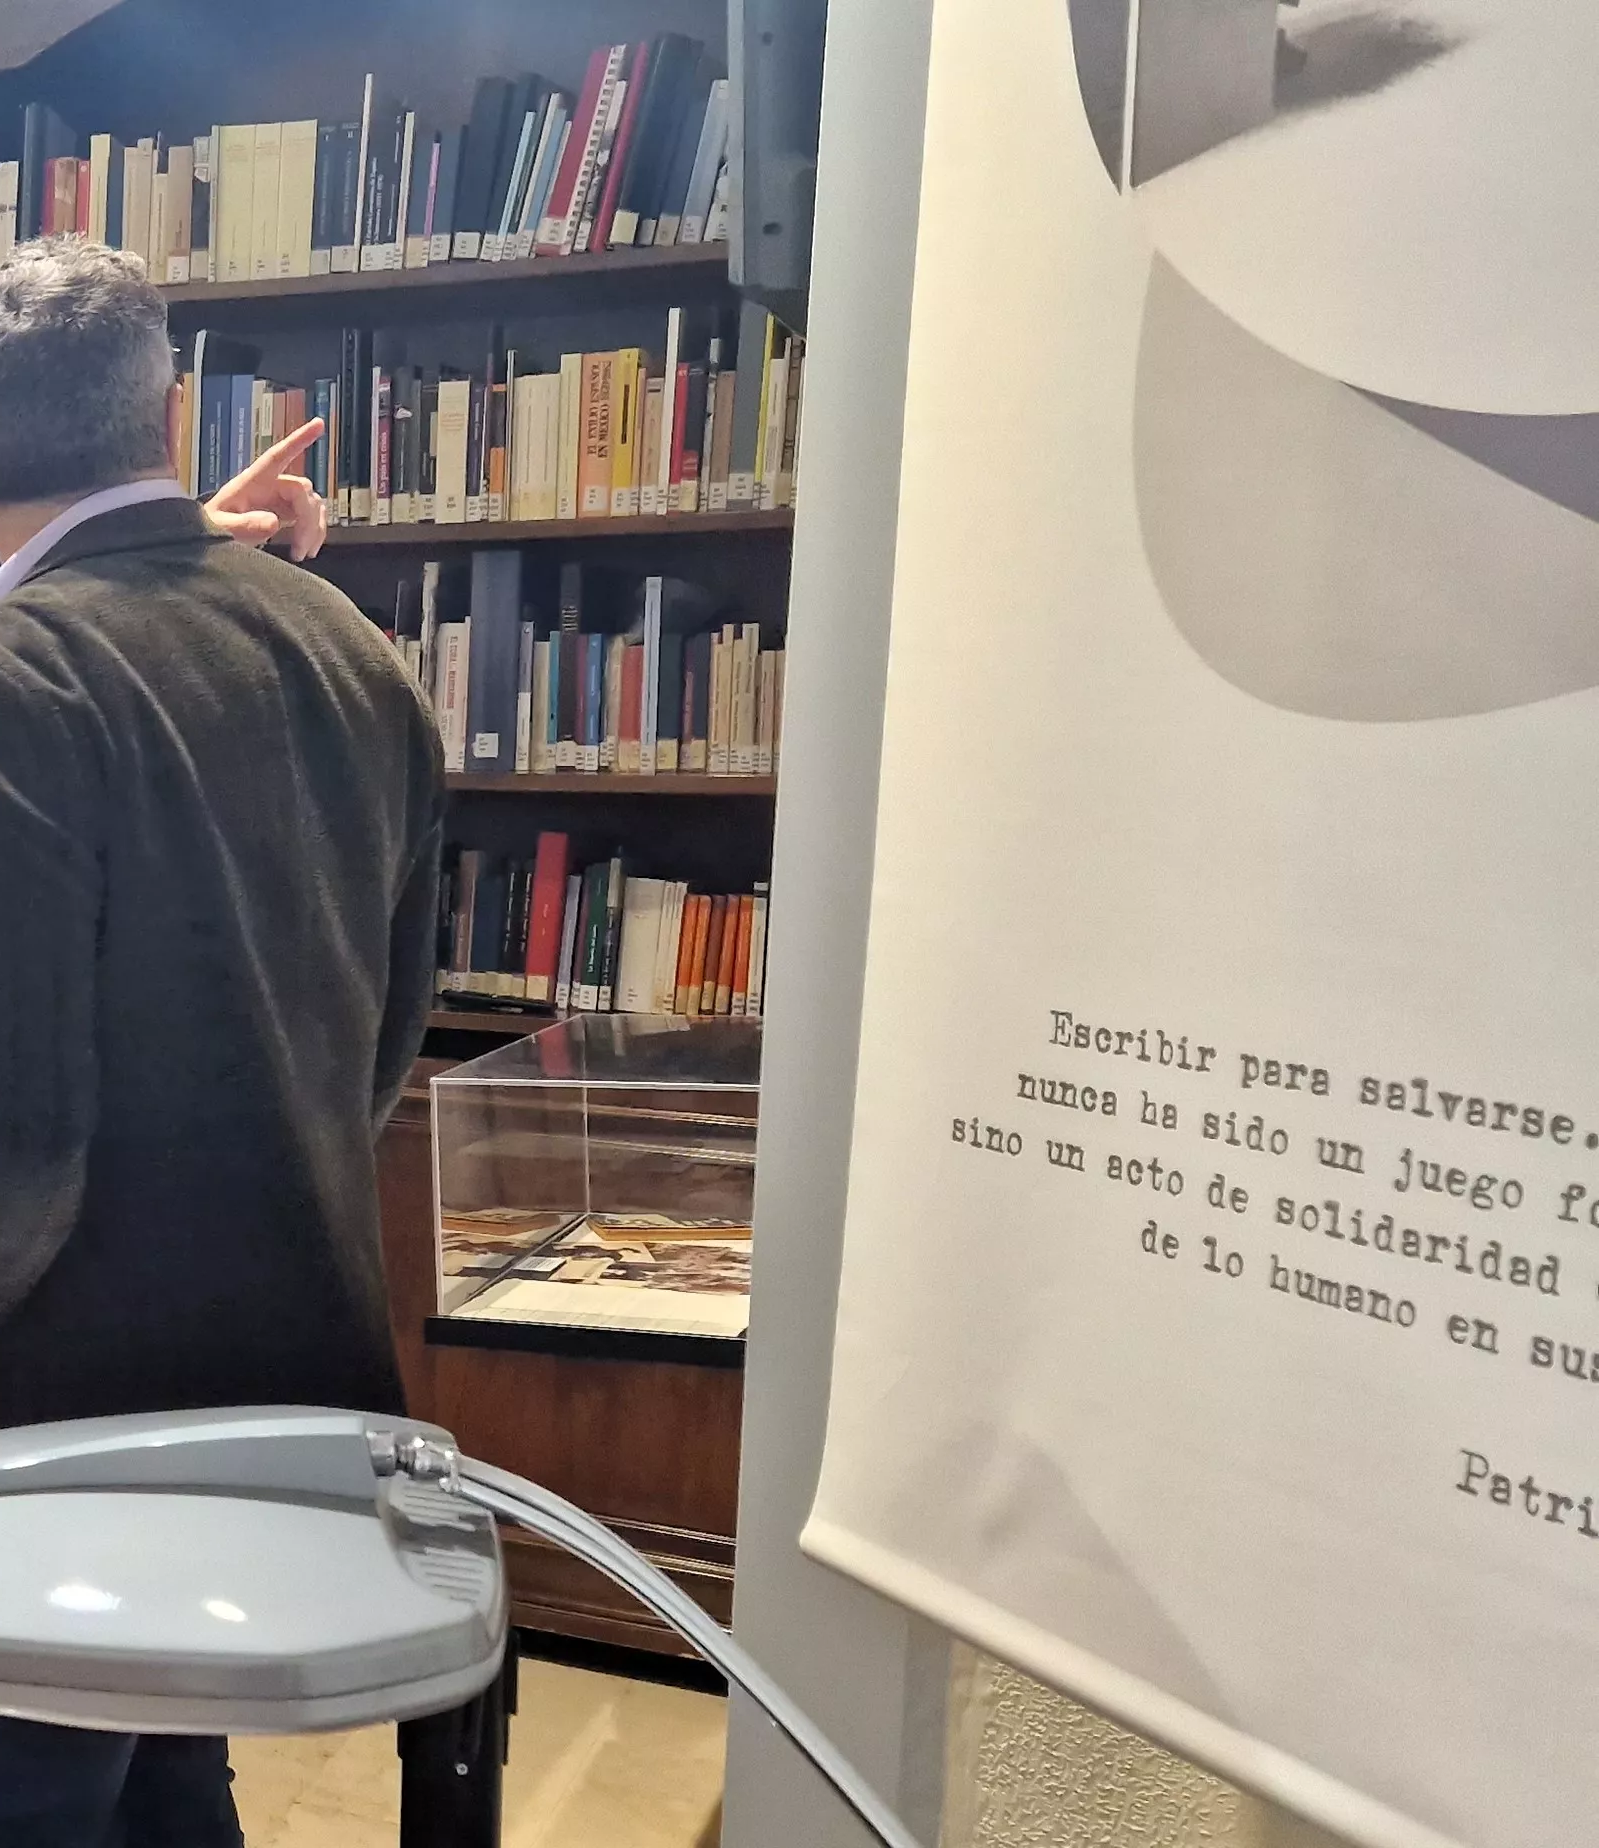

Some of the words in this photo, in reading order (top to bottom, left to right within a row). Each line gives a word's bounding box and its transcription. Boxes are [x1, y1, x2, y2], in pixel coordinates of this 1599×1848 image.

[1017, 1073, 1117, 1116] nunca
[1141, 1090, 1177, 1129] ha
[1202, 1112, 1288, 1155] sido
[1316, 1137, 1365, 1174] un
[1393, 1148, 1523, 1210] juego
[1049, 1010, 1216, 1072] Escribir
[1240, 1054, 1329, 1096] para
[1359, 1077, 1599, 1150] salvarse.
[952, 1117, 1022, 1156] sino
[1046, 1140, 1085, 1172] un
[1107, 1155, 1183, 1196] acto
[1207, 1173, 1249, 1213] de
[1275, 1197, 1560, 1296] solidaridad
[1141, 1220, 1179, 1259] de
[1202, 1236, 1244, 1278] lo
[1270, 1254, 1416, 1328] humano
[1446, 1314, 1499, 1355] en
